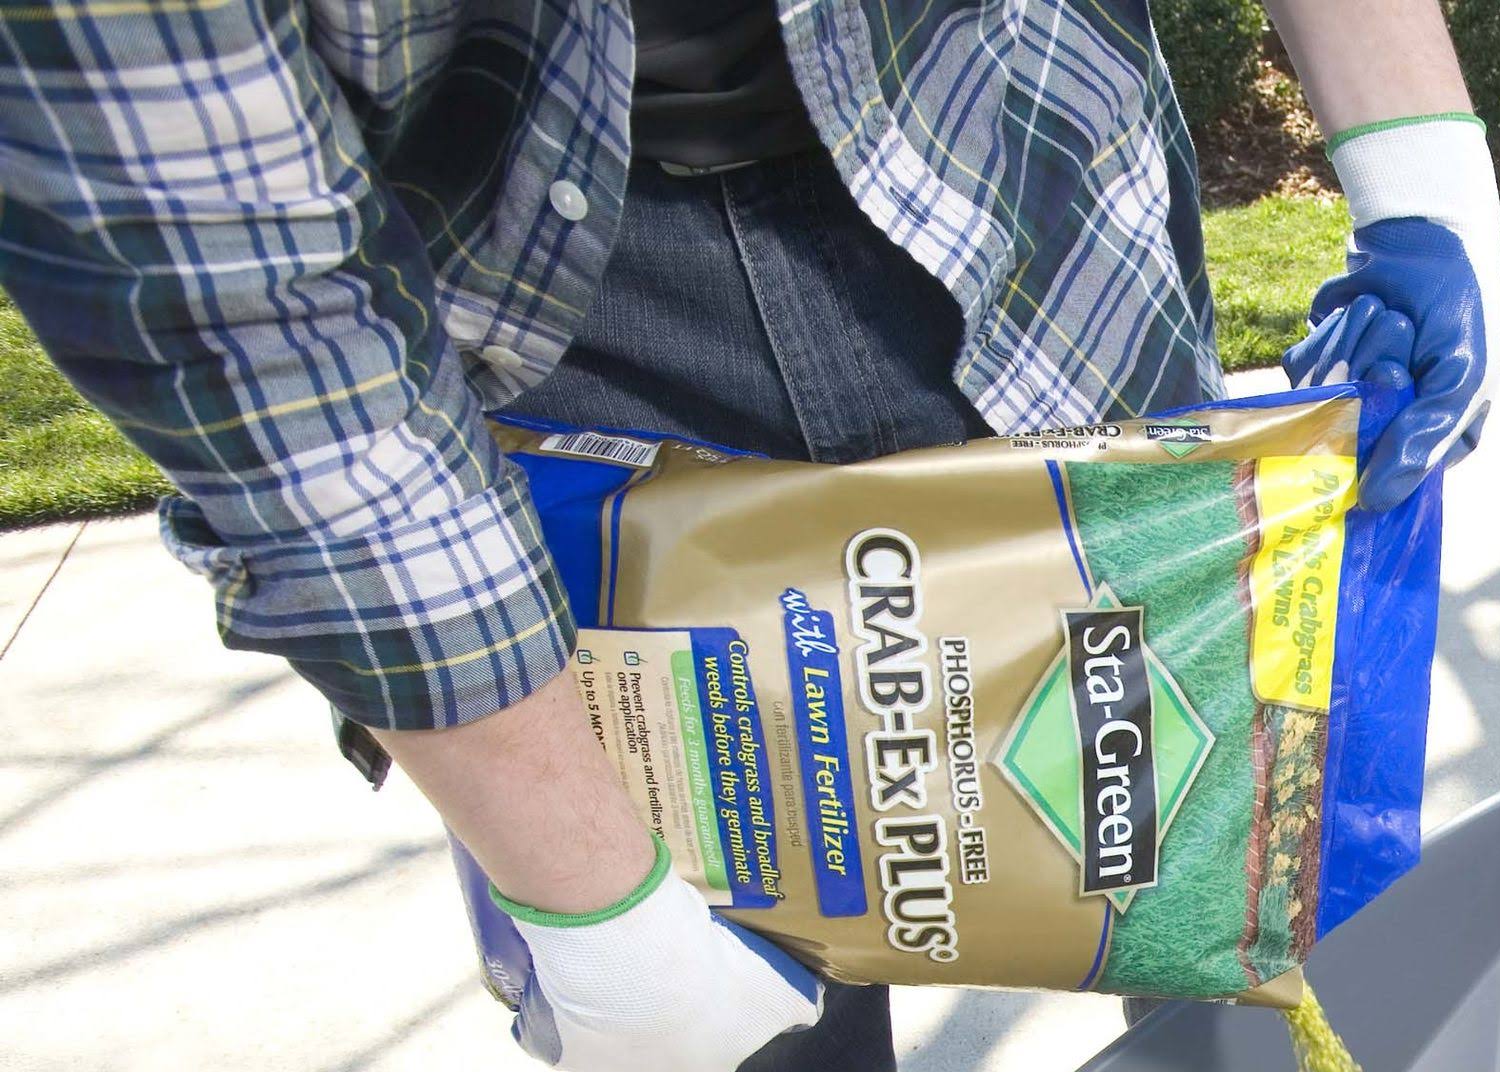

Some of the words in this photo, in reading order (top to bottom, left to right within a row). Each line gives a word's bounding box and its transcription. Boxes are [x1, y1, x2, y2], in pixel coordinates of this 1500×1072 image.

[783, 590, 837, 657] with
[1293, 576, 1323, 695] Crabgrass
[580, 671, 594, 688] Up
[586, 690, 595, 701] to
[617, 672, 628, 692] one
[630, 672, 644, 712] Prevent
[679, 677, 695, 712] Feeds
[704, 656, 727, 709] weeds
[729, 640, 755, 713] Controls
[618, 695, 638, 754] application
[685, 717, 697, 735] for
[804, 667, 830, 744] Lawn
[636, 714, 652, 763] crabgrass
[712, 713, 732, 772] before
[738, 717, 760, 792] crabgrass
[644, 766, 657, 785] and
[690, 749, 706, 795] months
[719, 770, 740, 805] they
[648, 787, 664, 824] fertilize
[749, 795, 770, 826] and
[813, 754, 848, 876] Fertilizer
[652, 827, 666, 841] yo
[694, 798, 720, 867] guaranteed!
[721, 807, 752, 884] germinate
[752, 824, 784, 899] broadleaf
